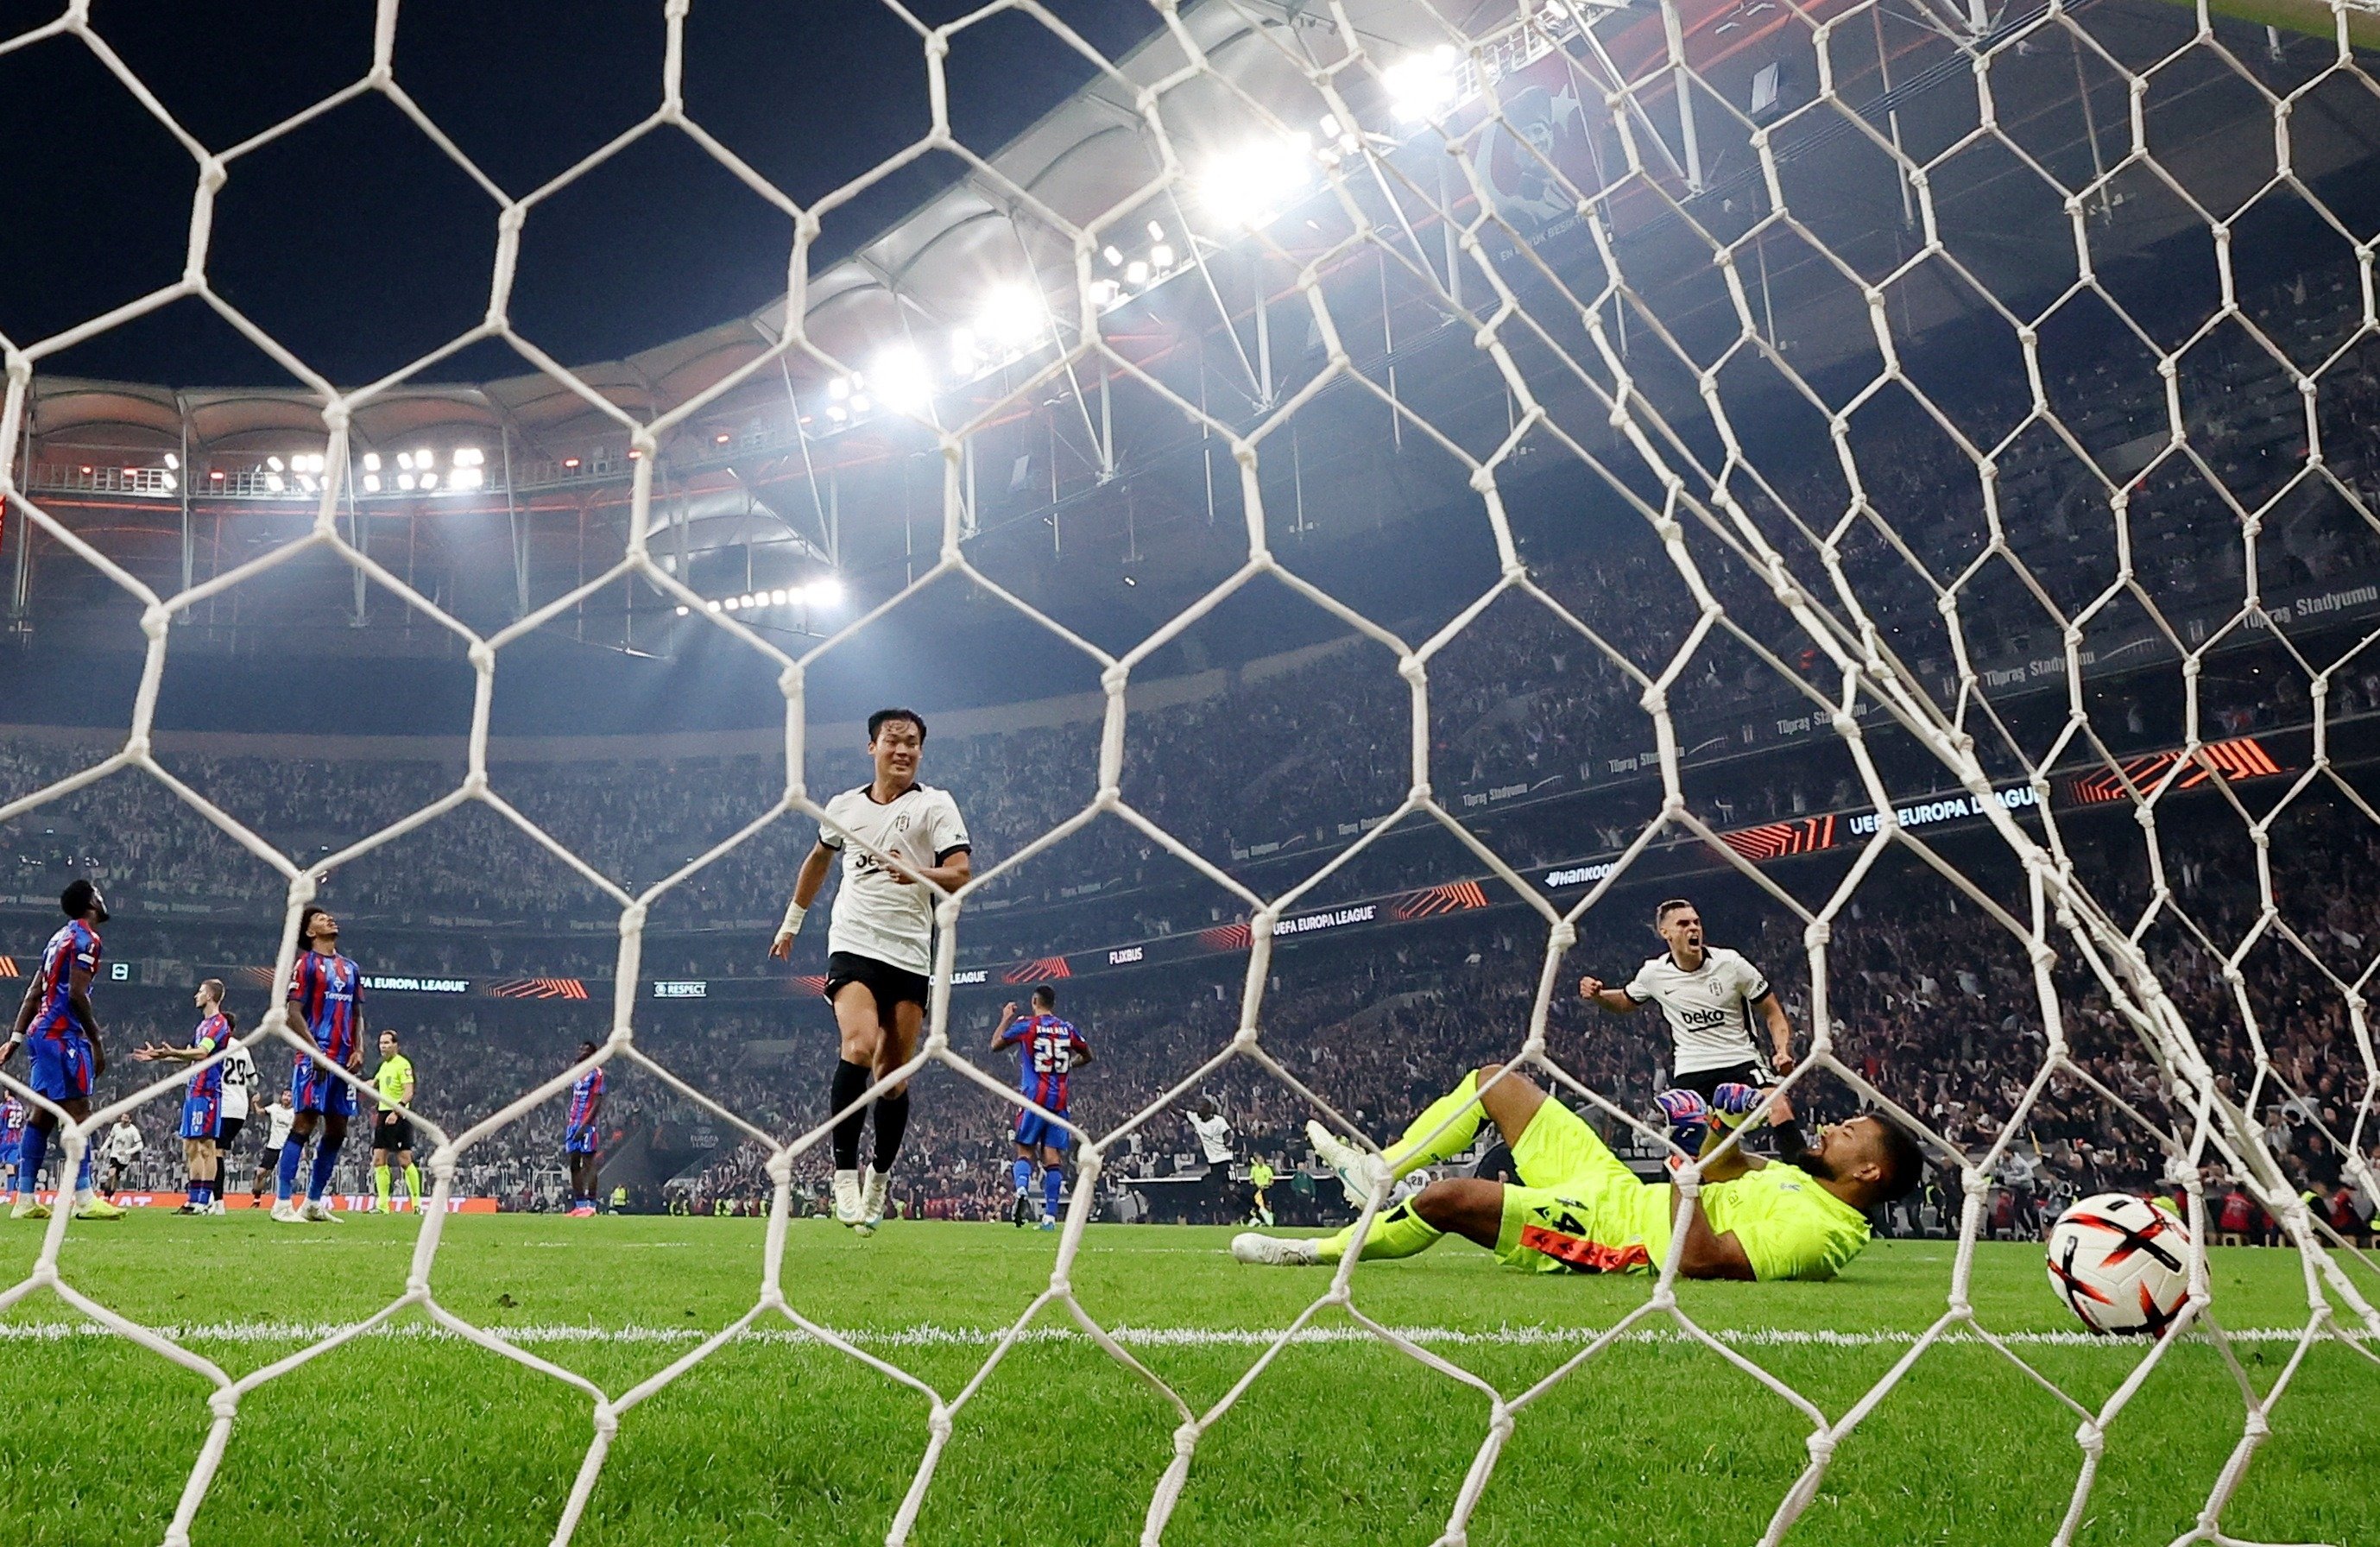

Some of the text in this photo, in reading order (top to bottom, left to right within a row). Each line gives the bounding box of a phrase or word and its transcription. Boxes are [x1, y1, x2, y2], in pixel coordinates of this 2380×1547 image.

[2295, 585, 2378, 616] Stadyumu
[1849, 813, 1892, 836] UEF
[1897, 798, 1969, 827] EUROPA
[1273, 905, 1374, 936] UEFA EUROPA LEAGUE
[374, 977, 420, 991] EUROPA
[420, 979, 466, 992] LEAGUE
[950, 971, 987, 984] LEAGUE
[667, 984, 706, 994] RESPECT
[1033, 1038, 1070, 1073] 25
[224, 1058, 246, 1085] 29
[8, 1110, 23, 1128] 22
[1411, 1176, 1424, 1186] 28
